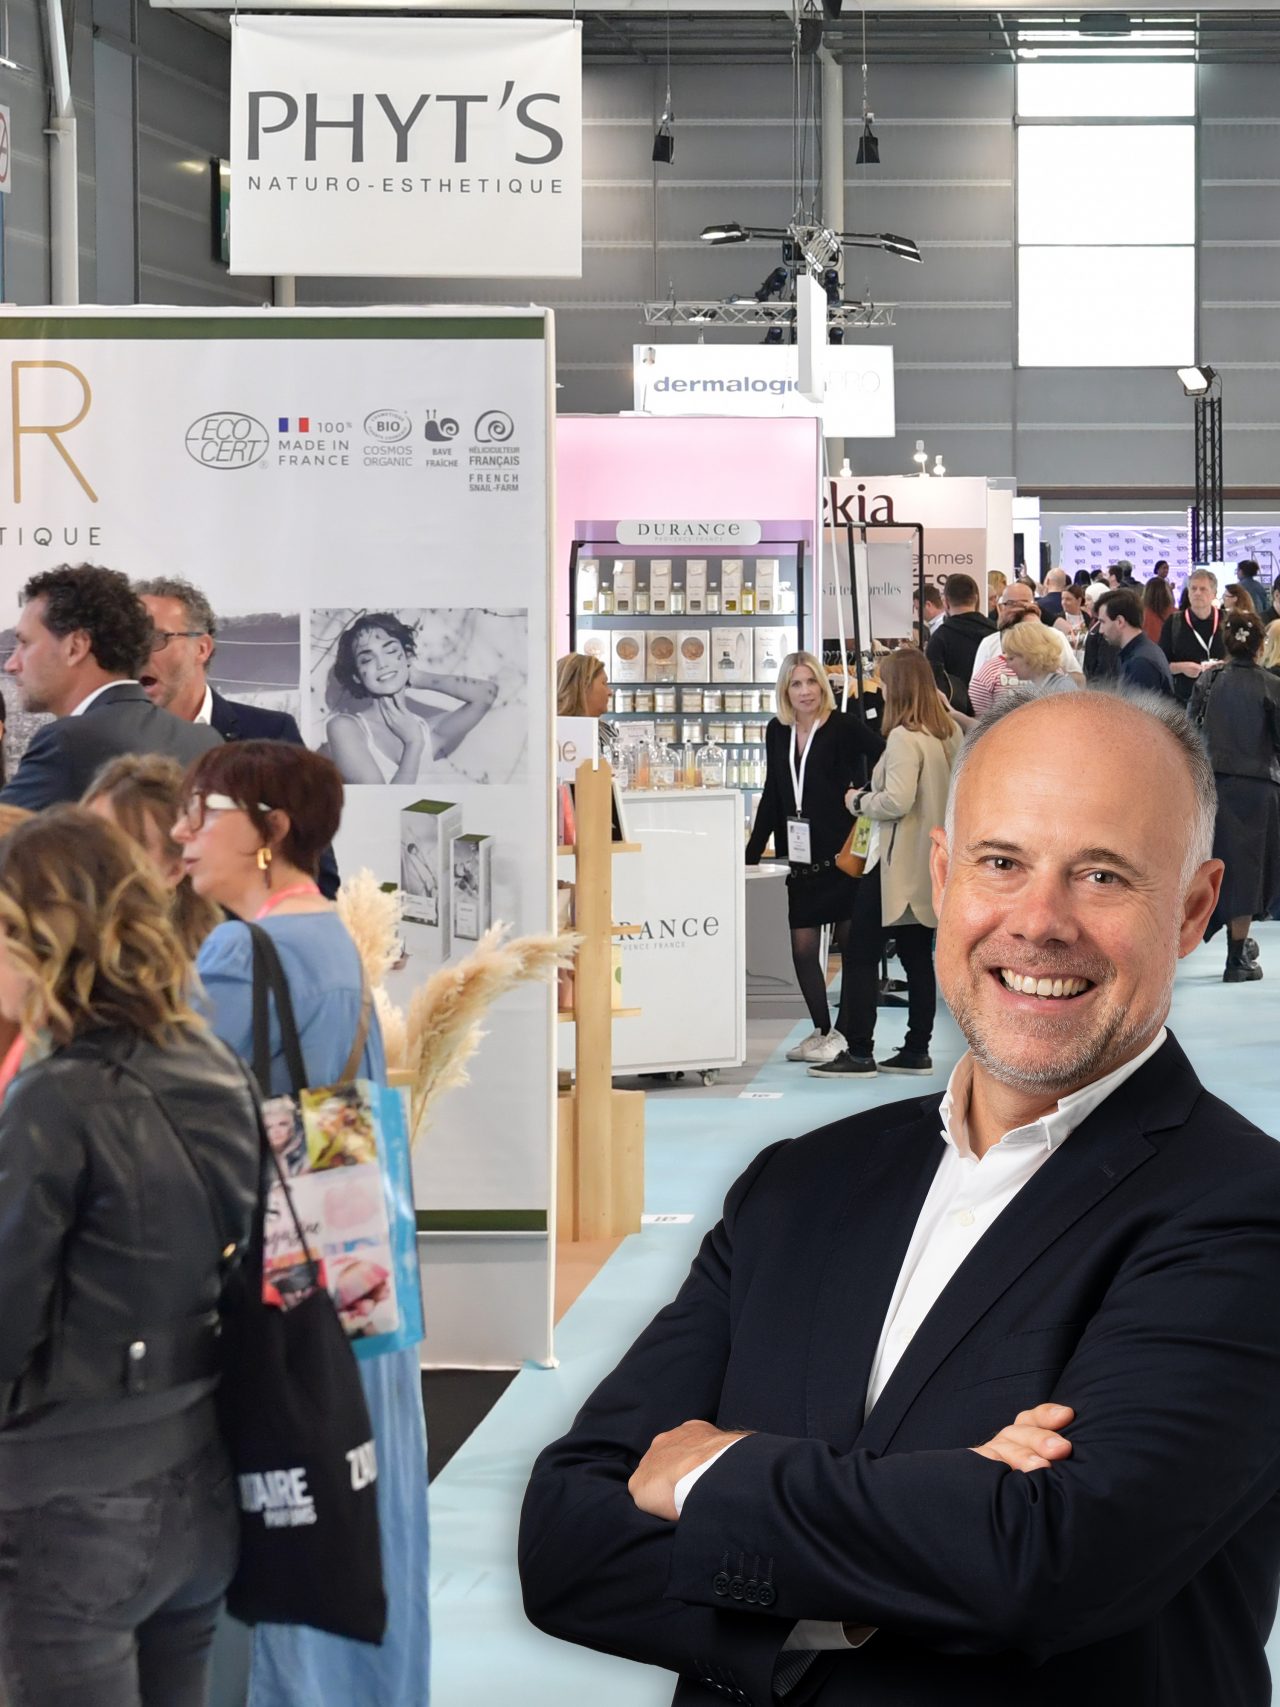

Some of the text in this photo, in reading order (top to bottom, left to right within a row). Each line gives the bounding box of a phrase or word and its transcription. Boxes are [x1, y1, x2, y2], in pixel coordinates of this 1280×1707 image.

[247, 80, 564, 165] PHYT'S
[248, 175, 564, 195] NATURO-ESTHETIQUE
[653, 375, 828, 396] dermalogi
[201, 418, 252, 441] ECO
[376, 420, 401, 432] BIO
[200, 440, 262, 462] CERT
[278, 440, 350, 451] MADE IN
[363, 445, 413, 456] COSMOS
[432, 447, 452, 456] BAVE
[278, 455, 350, 466] FRANCE
[363, 457, 413, 467] ORGANIC
[469, 456, 520, 468] FRANÇAIS
[469, 473, 519, 483] FRENCH
[469, 484, 519, 492] SNAIL-FARM
